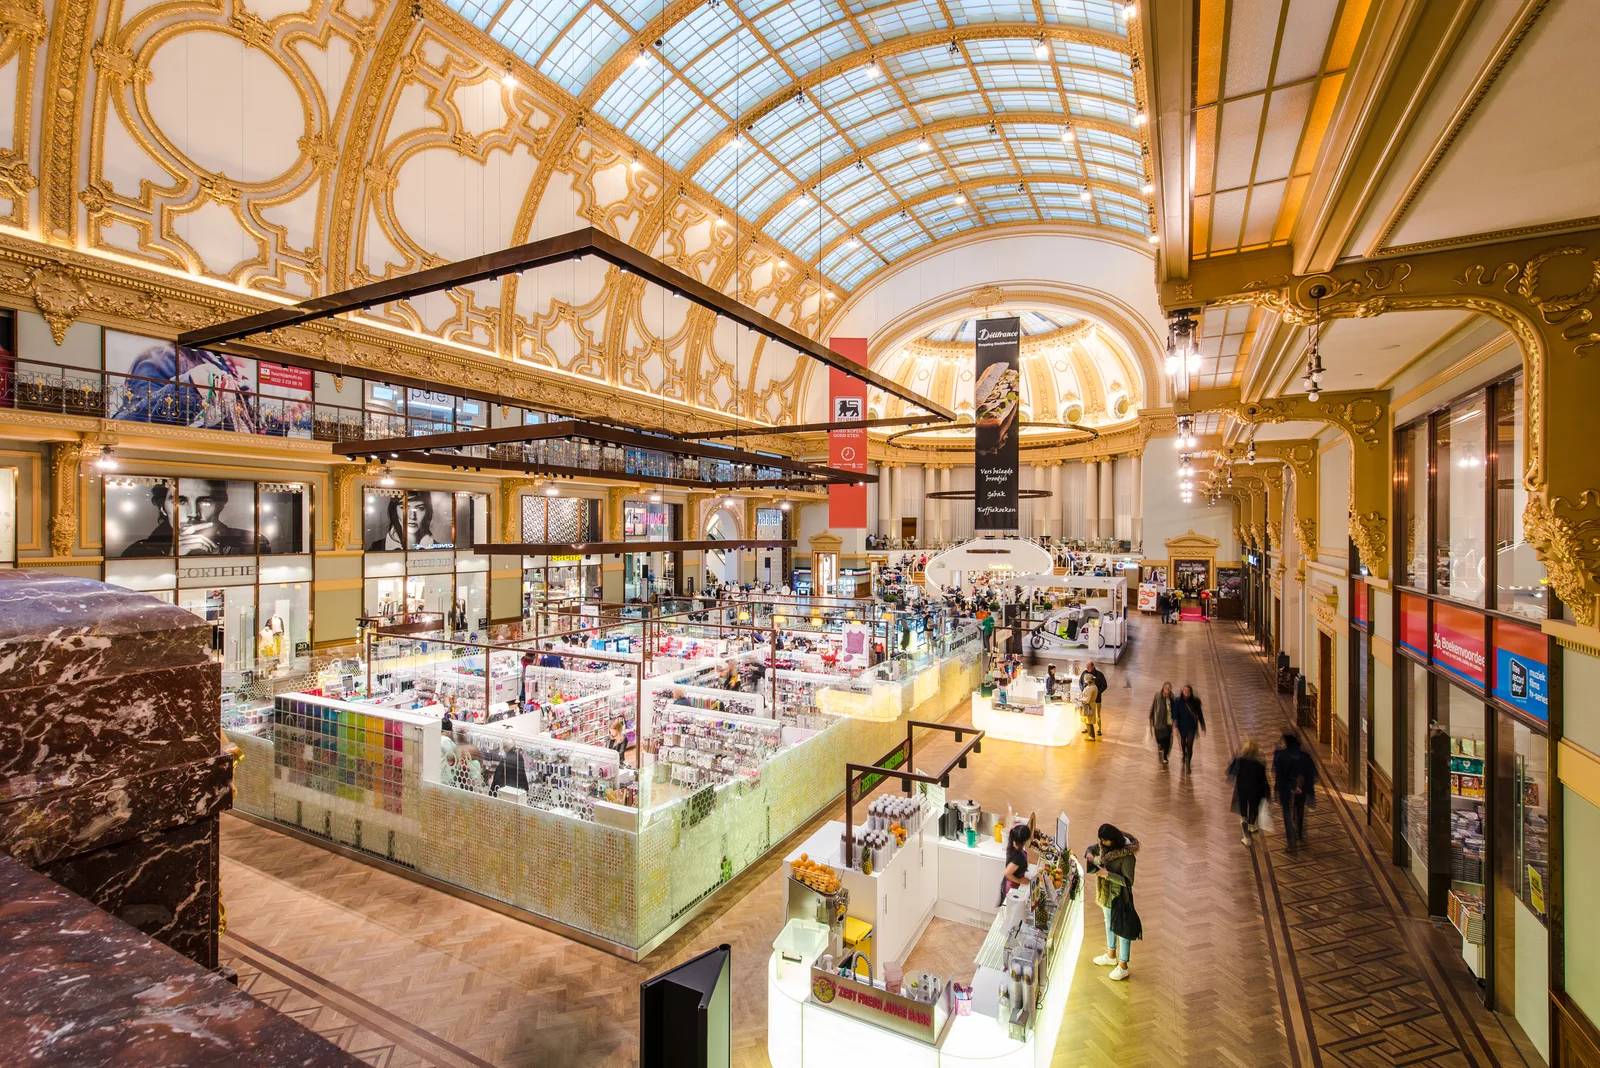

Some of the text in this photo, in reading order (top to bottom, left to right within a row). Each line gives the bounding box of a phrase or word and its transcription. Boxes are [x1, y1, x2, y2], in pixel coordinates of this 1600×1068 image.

[838, 984, 931, 1028] ZEST FRESH JUICE BARS
